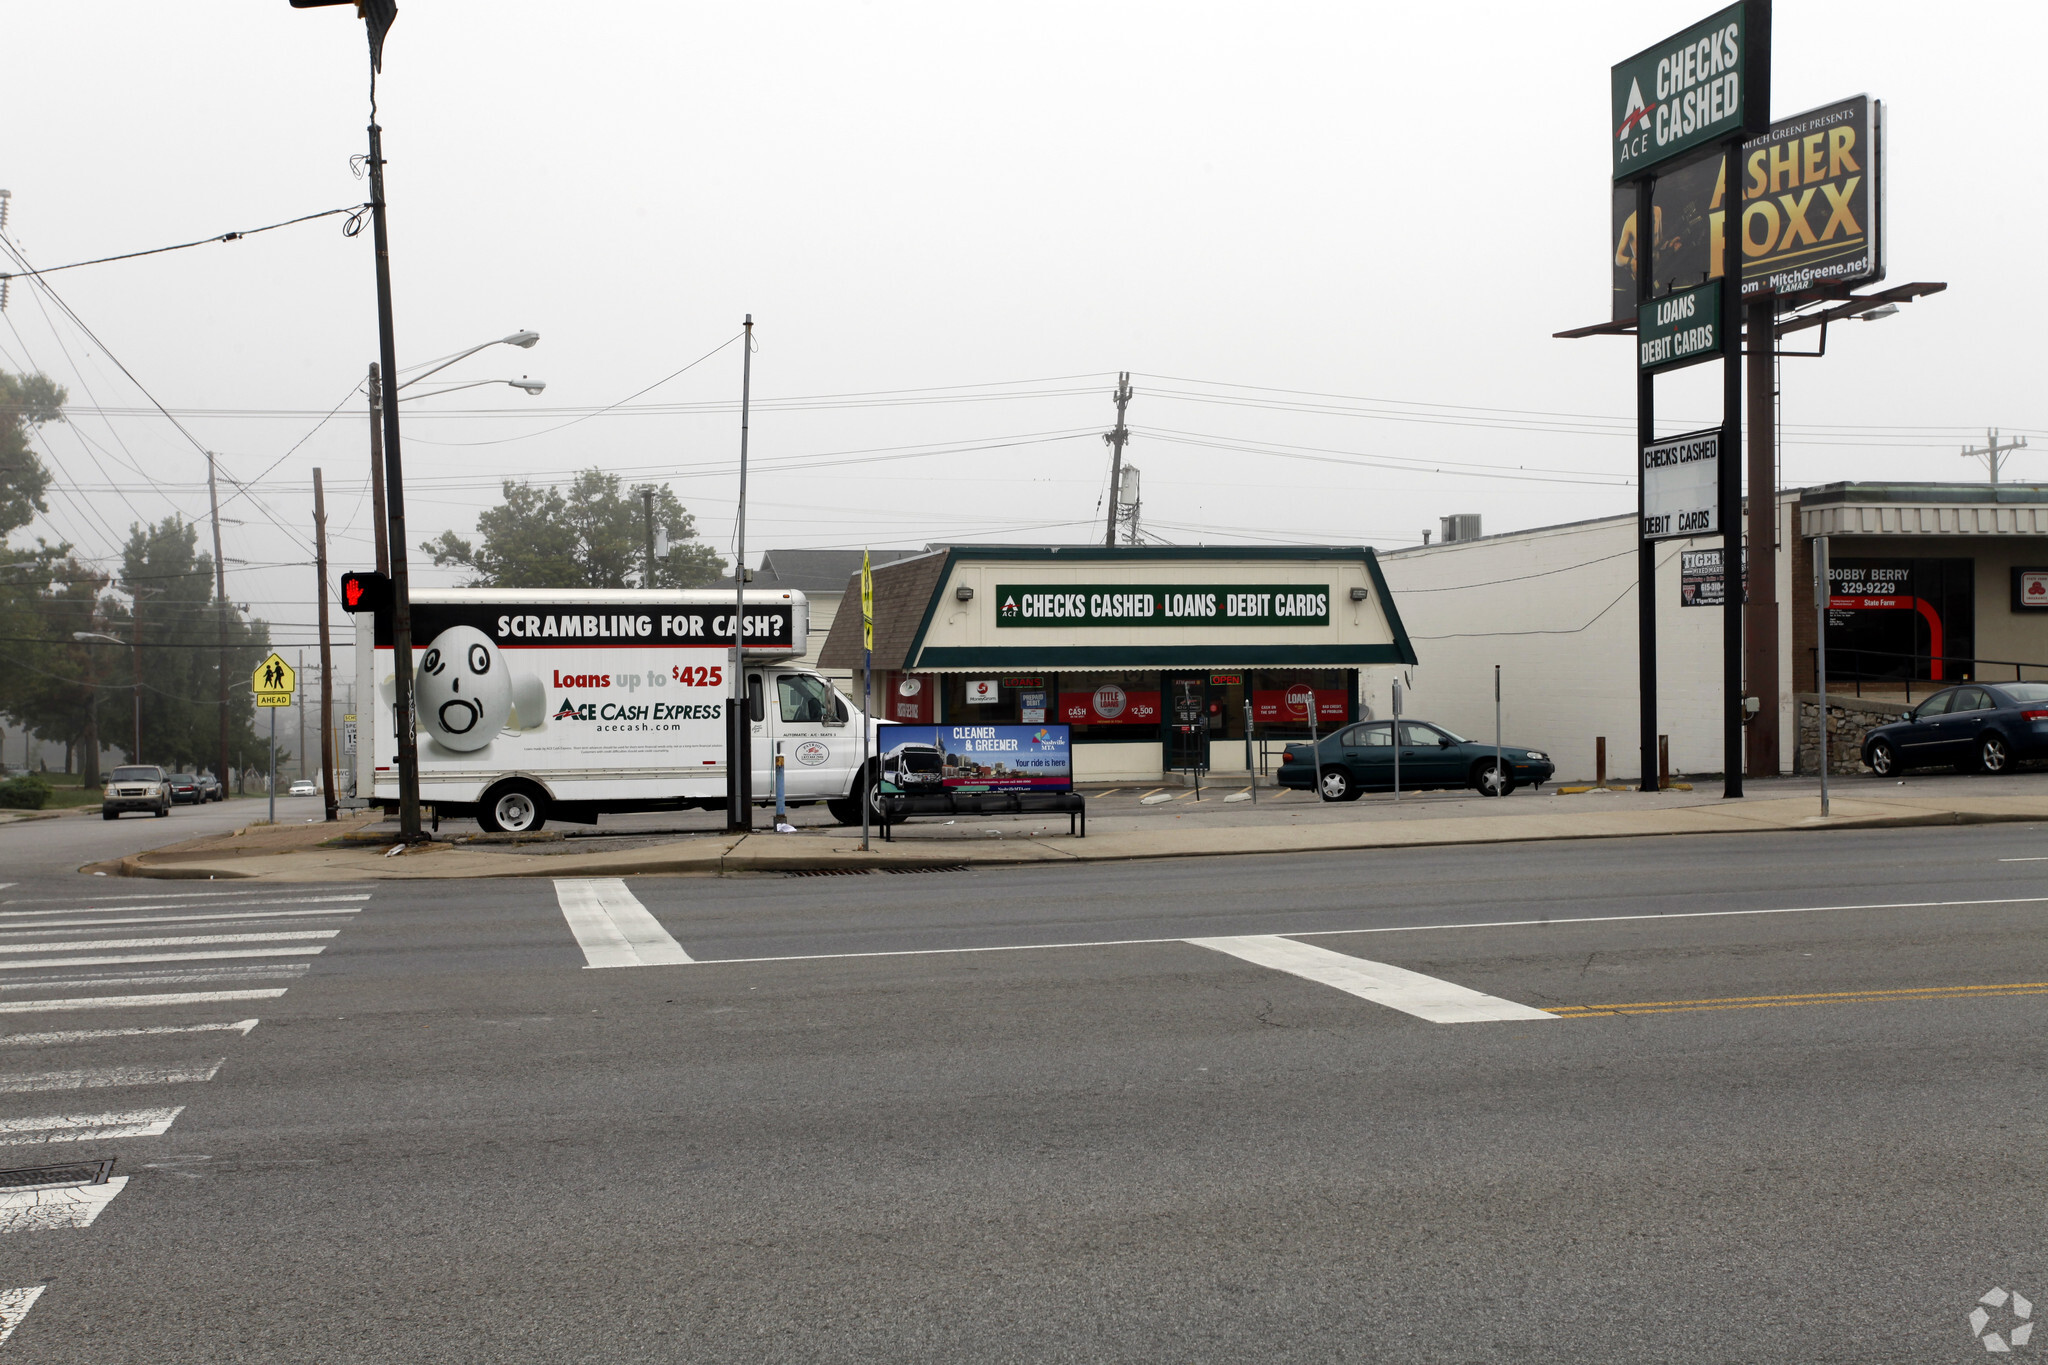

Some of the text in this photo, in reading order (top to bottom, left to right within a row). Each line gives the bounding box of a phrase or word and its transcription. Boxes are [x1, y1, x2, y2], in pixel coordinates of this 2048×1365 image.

[1657, 22, 1738, 101] CHECKS
[1656, 71, 1739, 147] CASHED
[1772, 122, 1807, 141] GREENE
[1809, 108, 1854, 130] PRESENTS
[1620, 133, 1648, 164] ACE
[1769, 256, 1868, 287] MitchGreene.net
[1779, 280, 1809, 294] LAMAR
[1657, 293, 1695, 326] LOANS
[1641, 324, 1713, 365] DEBIT CARDS
[1644, 439, 1717, 469] CHECKS CASHED
[1644, 509, 1709, 534] DEBIT CARDS
[1682, 553, 1720, 569] TIGER
[1828, 568, 1909, 581] BOBBY BERRY
[1841, 582, 1895, 594] 329-9229
[1022, 593, 1327, 618] CHECKS CASHED LOANS DEBIT CARDS
[1864, 599, 1879, 607] State
[1880, 599, 1895, 607] Farm
[498, 614, 784, 637] SCRAMBLING FOR CASH?
[553, 664, 723, 693] Loans up to $425
[1005, 678, 1041, 687] LOANS
[1212, 676, 1240, 684] OPEN
[261, 696, 287, 704] AHEAD
[1022, 693, 1044, 701] PREPAID
[1099, 691, 1119, 701] TITLE
[556, 697, 722, 721] ACE CASH EXPRESS
[1131, 707, 1153, 715] $2,500
[596, 722, 681, 732] acecash.com
[953, 727, 996, 739] CLEANER
[965, 739, 1018, 751] & GREENER
[1015, 758, 1066, 767] Your ride is here
